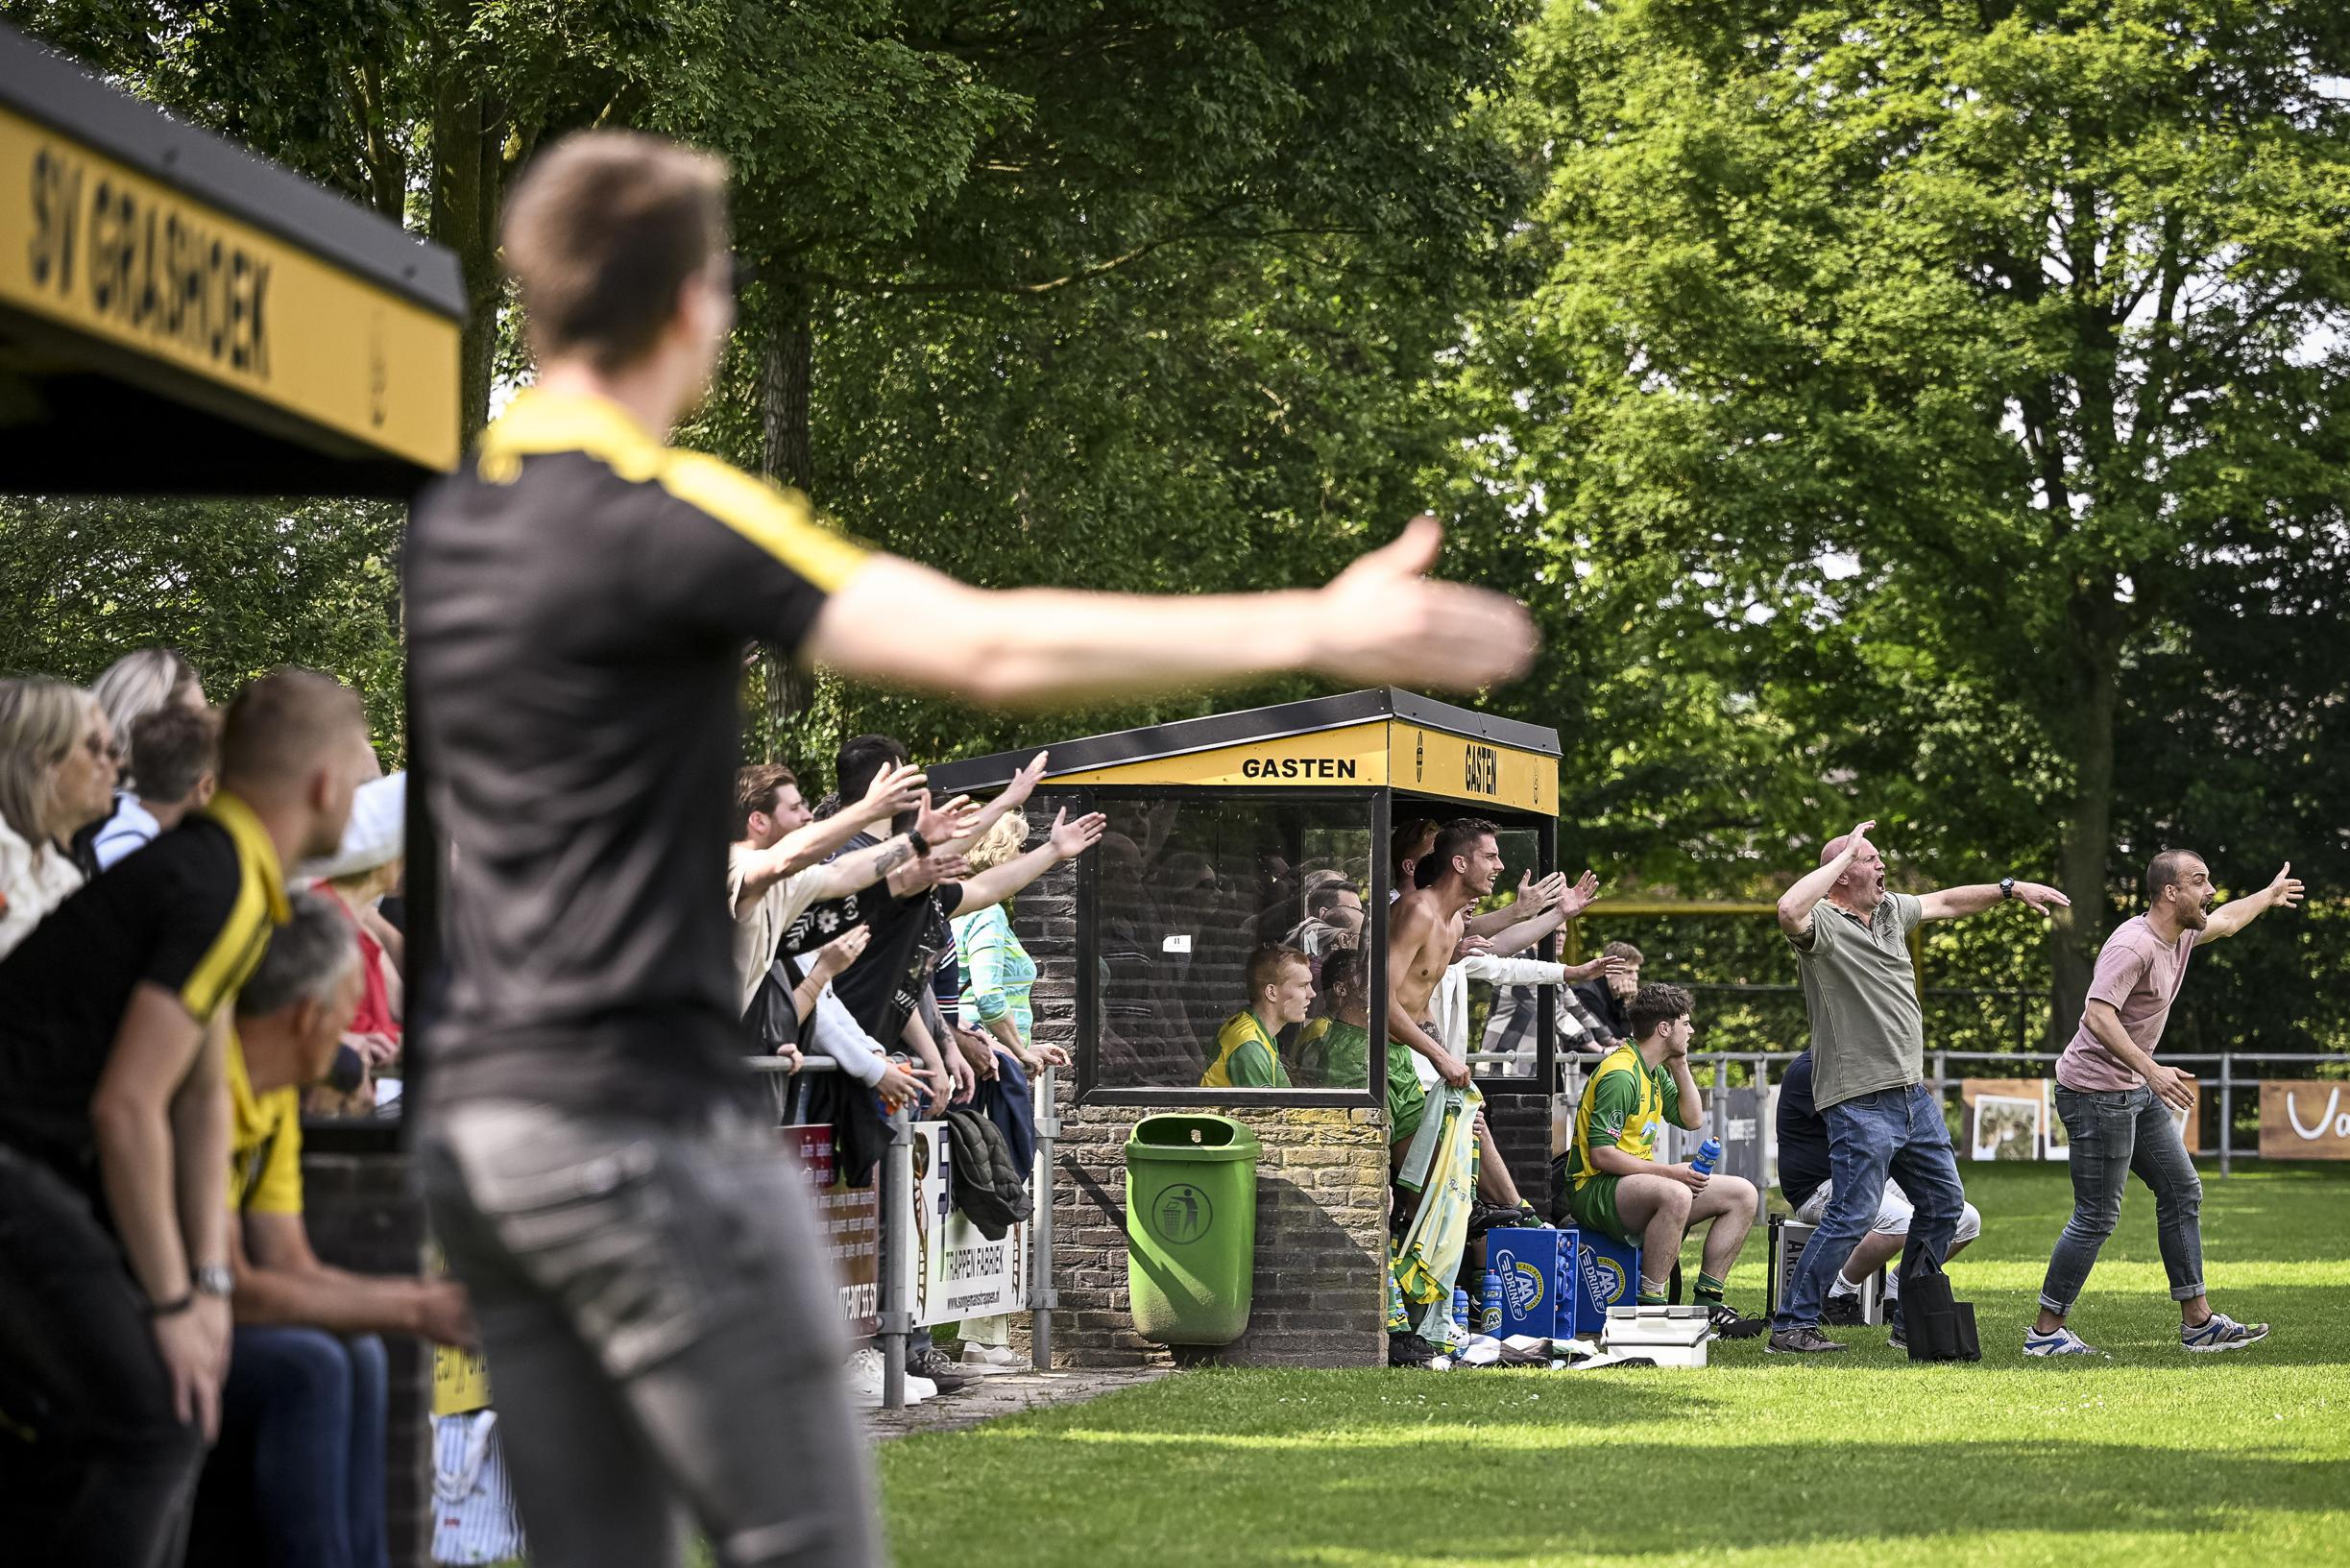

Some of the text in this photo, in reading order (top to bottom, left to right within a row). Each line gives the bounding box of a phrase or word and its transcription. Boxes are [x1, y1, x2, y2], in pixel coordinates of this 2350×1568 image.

[1242, 759, 1356, 779] GASTEN
[1465, 743, 1497, 796] GASTEN
[946, 1244, 1005, 1281] TRAPPEN FABRIEK
[1504, 1270, 1522, 1309] DRINK
[1514, 1275, 1535, 1303] AA
[1585, 1266, 1604, 1301] DRINK
[1595, 1269, 1616, 1296] AA
